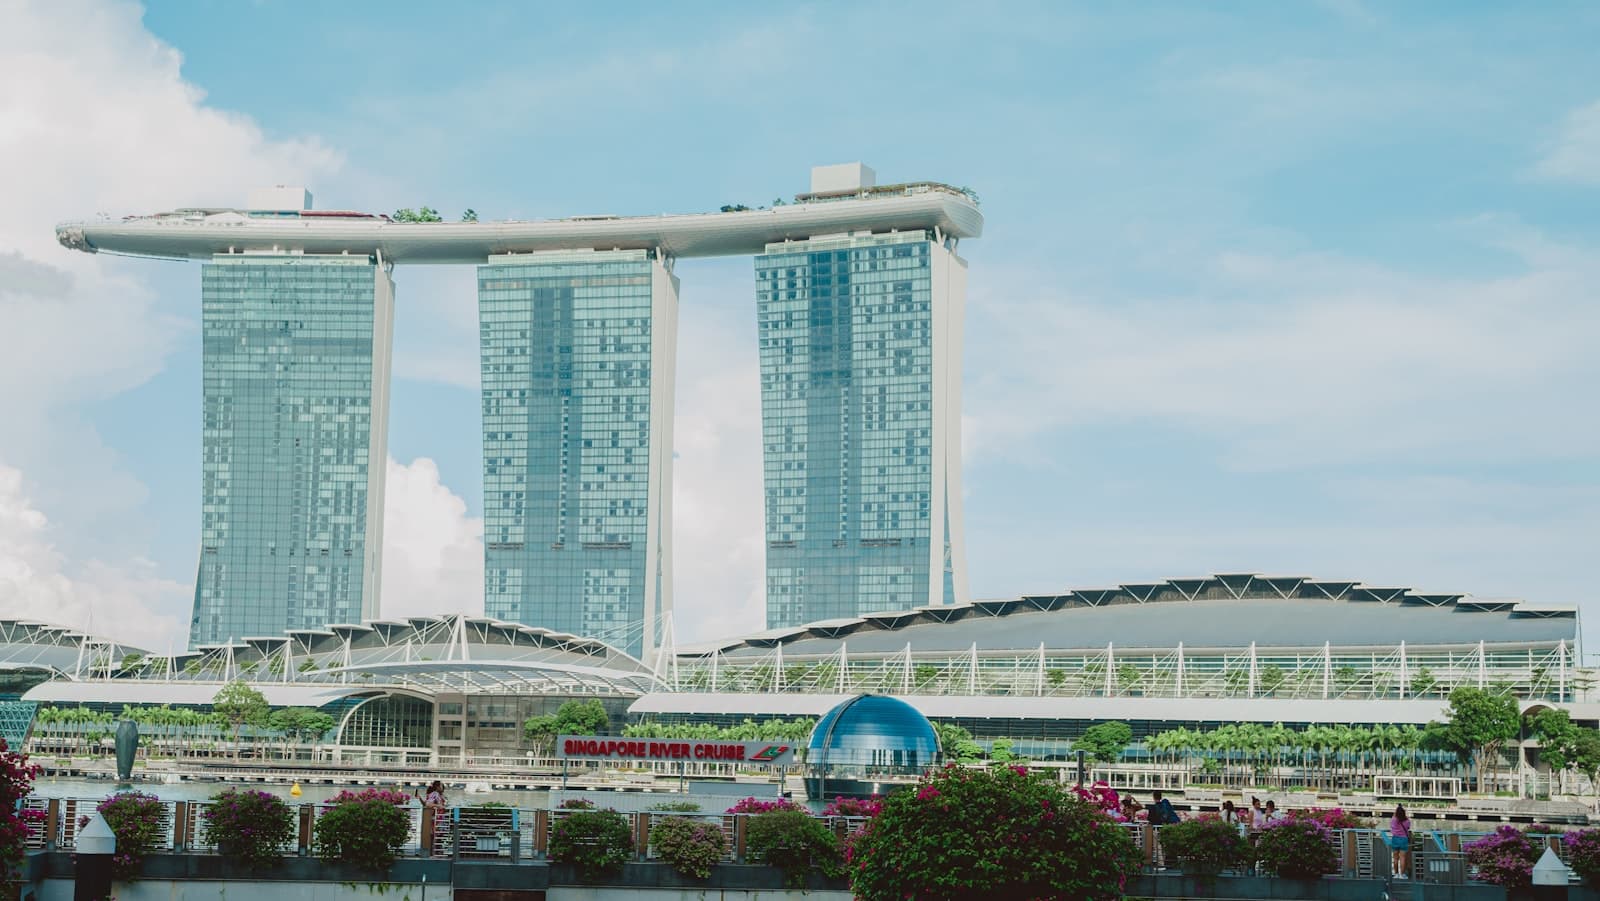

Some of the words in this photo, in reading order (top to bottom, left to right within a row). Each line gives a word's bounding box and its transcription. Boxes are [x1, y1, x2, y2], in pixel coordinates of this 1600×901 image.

[564, 740, 646, 756] SINGAPORE
[649, 742, 691, 758] RIVER
[694, 744, 745, 760] CRUISE
